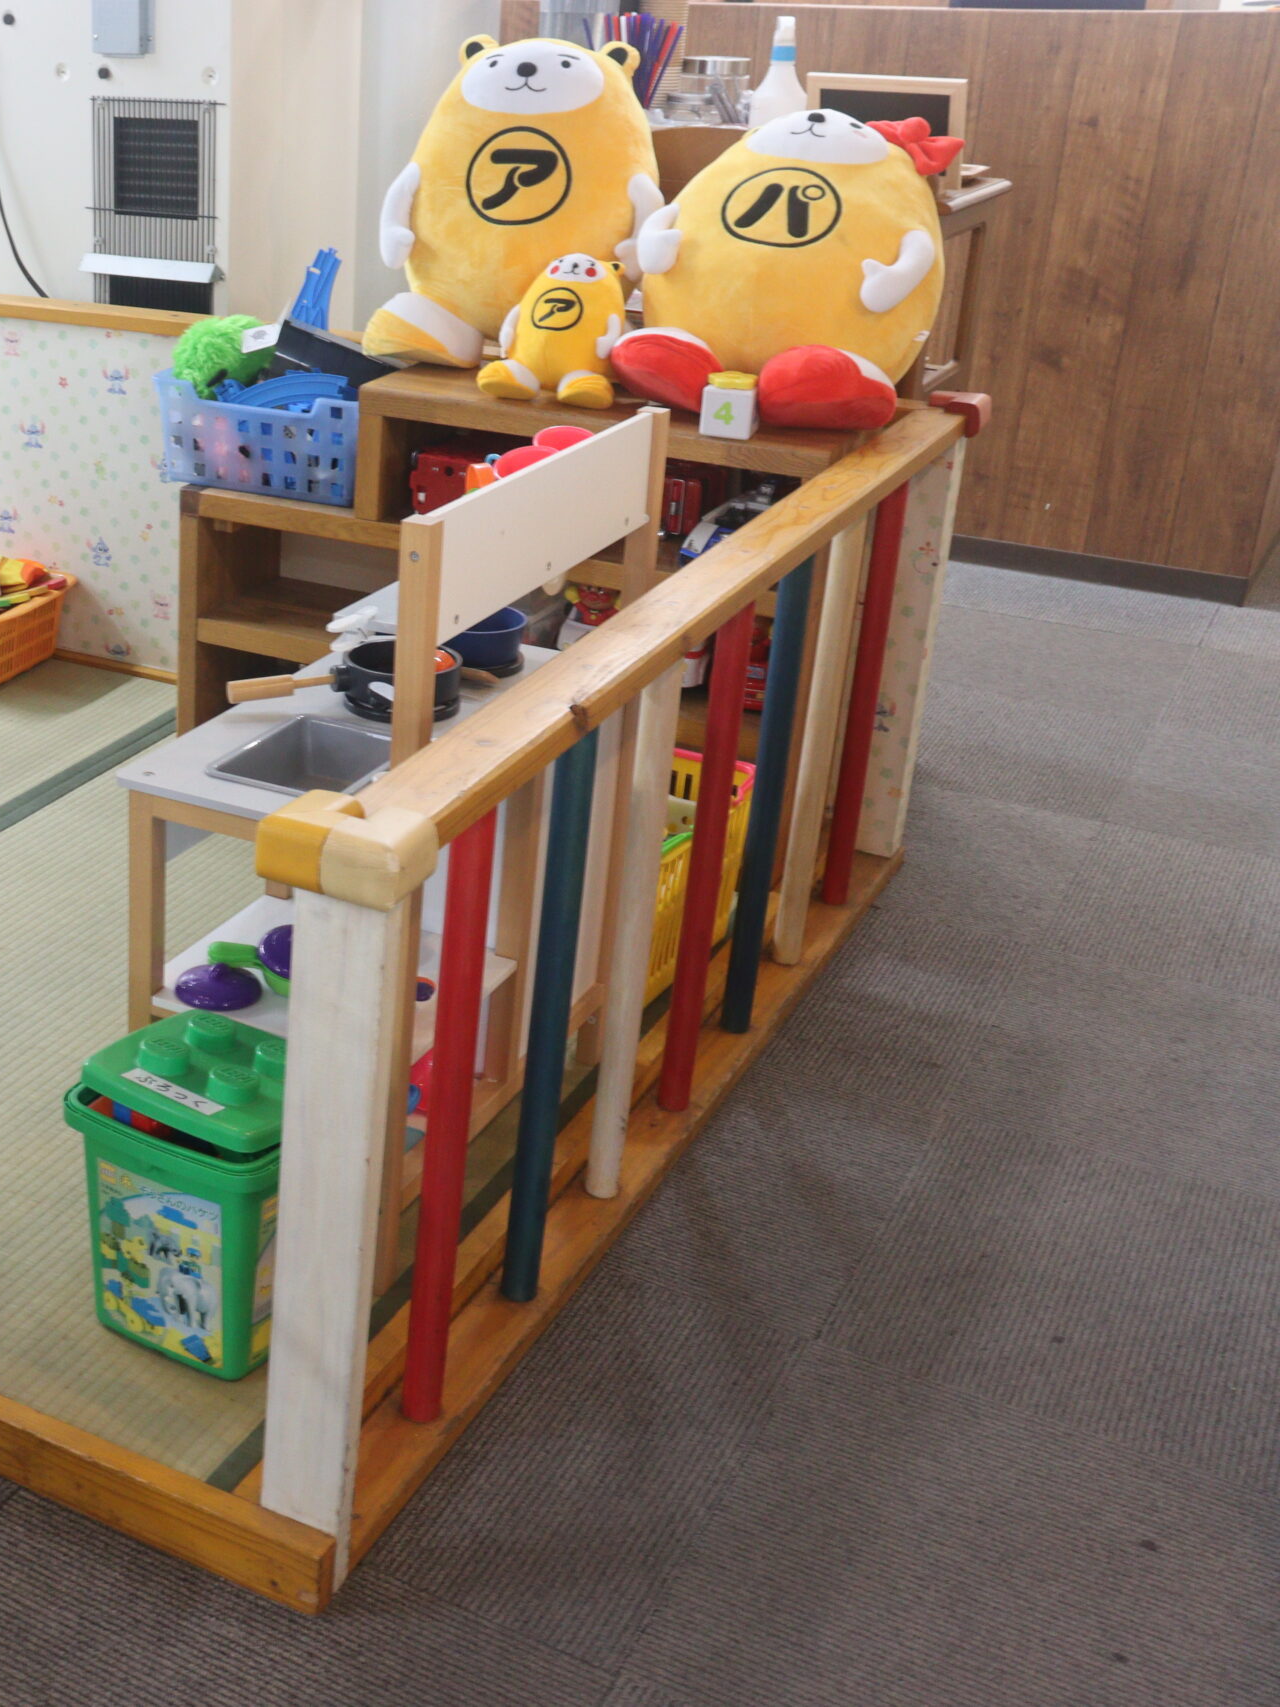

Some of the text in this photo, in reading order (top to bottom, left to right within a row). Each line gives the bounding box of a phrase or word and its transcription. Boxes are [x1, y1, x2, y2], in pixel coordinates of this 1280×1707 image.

[481, 148, 559, 211] ア
[733, 182, 826, 239] パ
[537, 297, 576, 323] ア
[713, 400, 735, 425] 4
